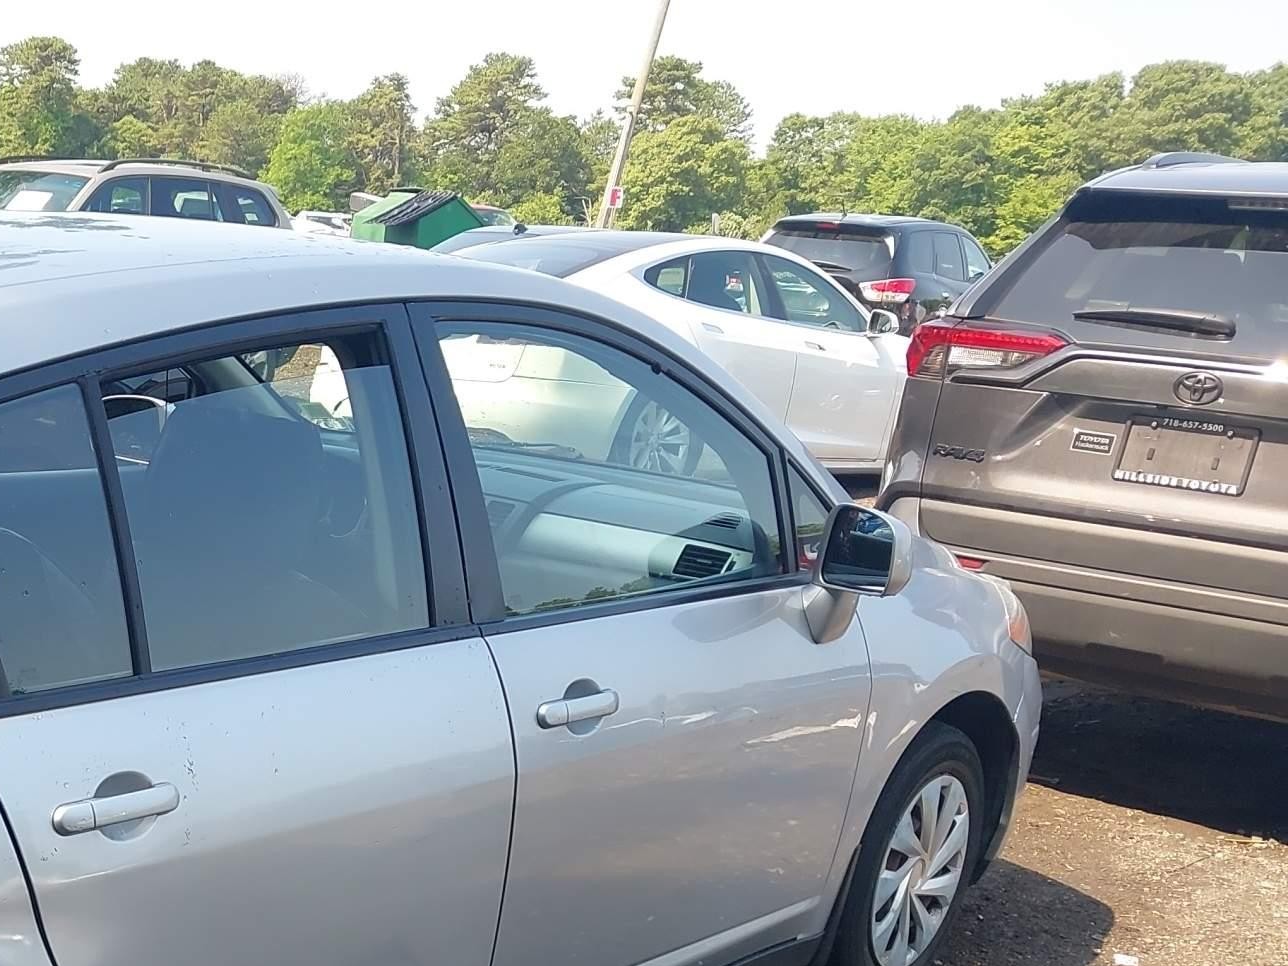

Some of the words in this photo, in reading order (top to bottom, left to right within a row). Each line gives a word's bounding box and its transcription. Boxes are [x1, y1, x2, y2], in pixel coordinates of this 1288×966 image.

[1162, 418, 1224, 432] 718-657-5500
[932, 443, 985, 463] RAV4
[1114, 469, 1177, 486] HILLSIDE
[1181, 479, 1237, 495] TOYOTA
